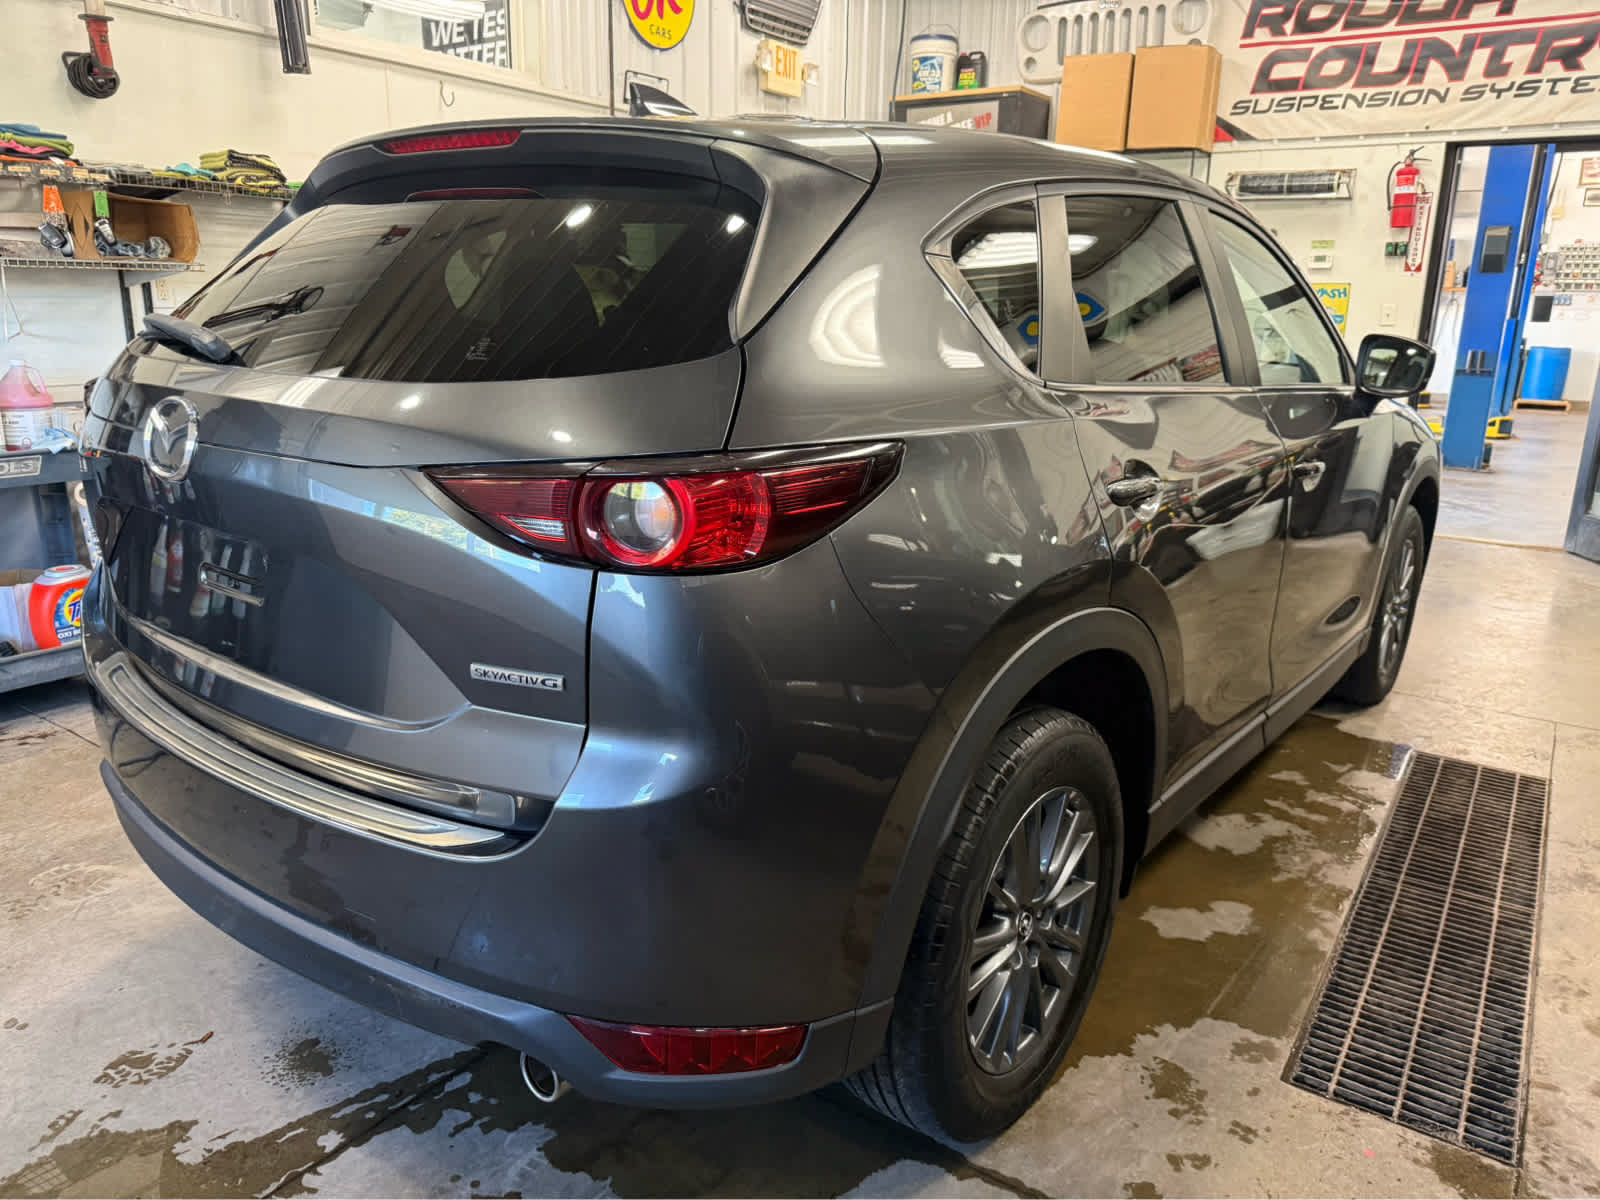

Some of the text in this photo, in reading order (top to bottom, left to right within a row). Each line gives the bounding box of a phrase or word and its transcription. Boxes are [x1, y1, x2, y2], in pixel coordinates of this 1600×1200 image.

[429, 18, 465, 47] WE
[649, 23, 672, 40] CARS
[775, 45, 798, 80] EXIT
[1251, 20, 1600, 94] COUNTR
[1230, 74, 1600, 117] SUSPENSION SYSTE
[68, 600, 81, 622] Ti
